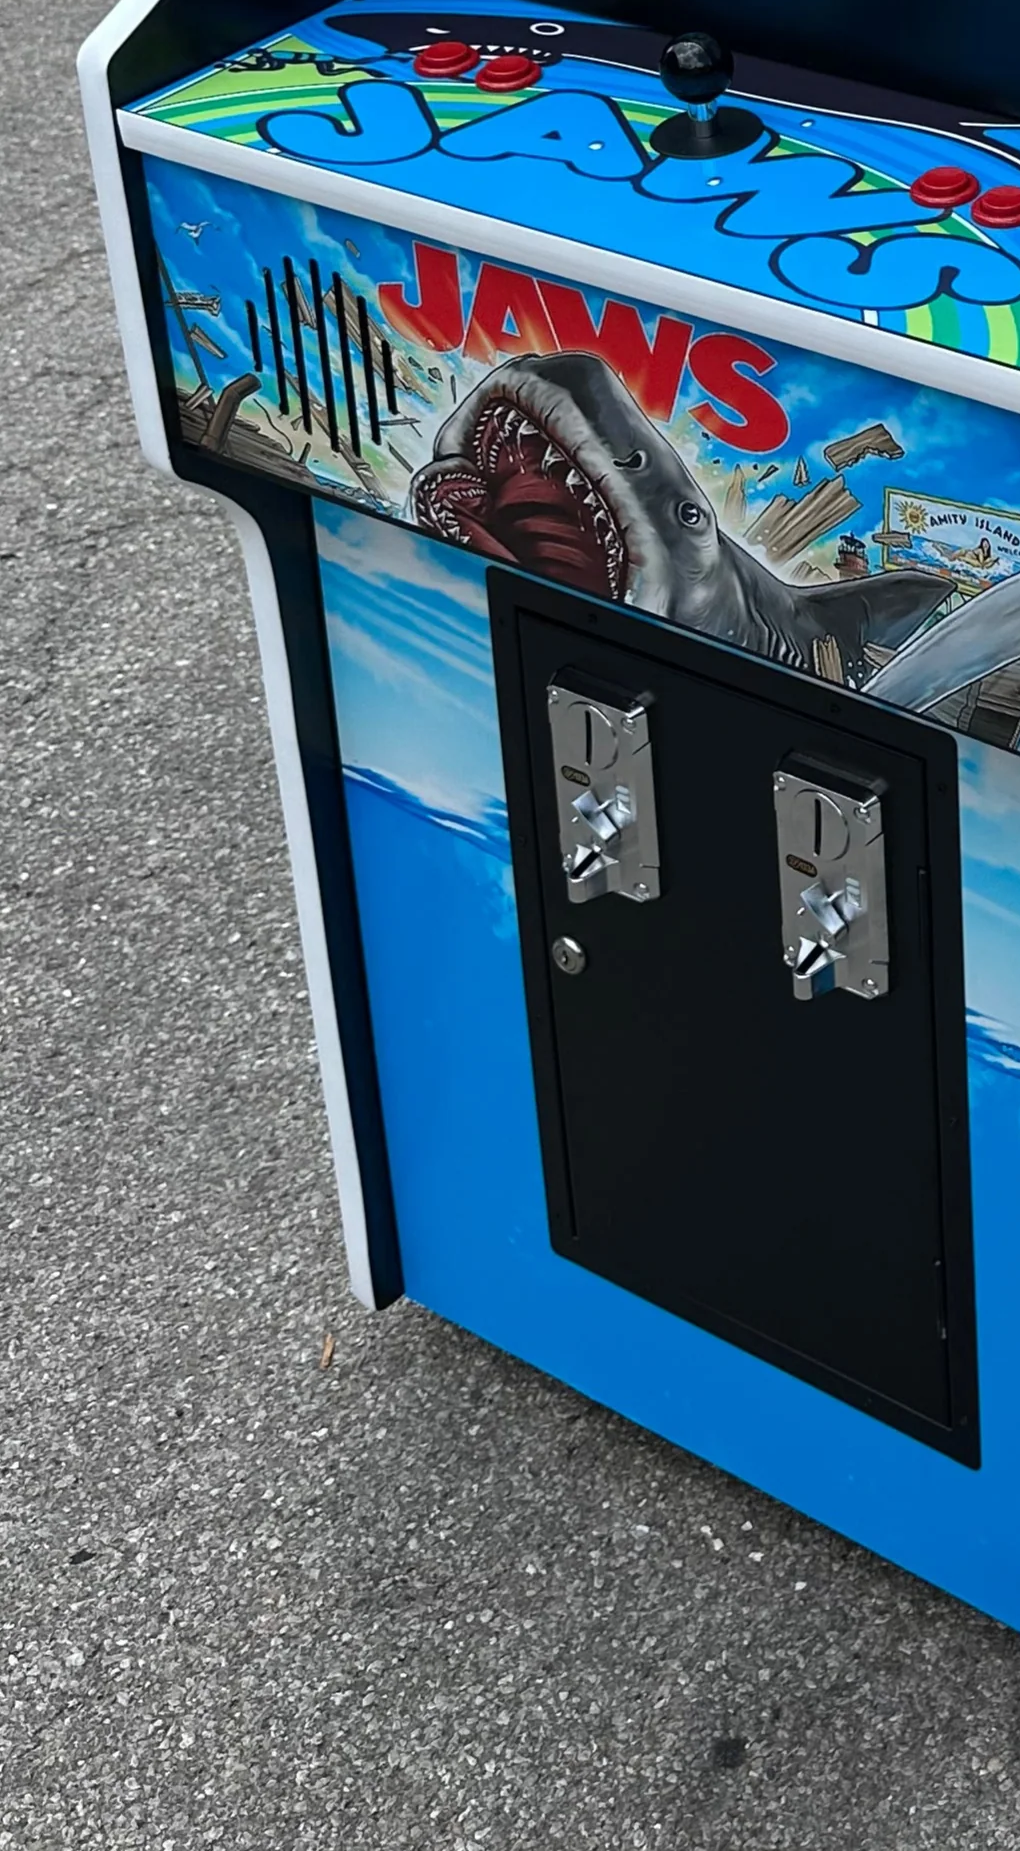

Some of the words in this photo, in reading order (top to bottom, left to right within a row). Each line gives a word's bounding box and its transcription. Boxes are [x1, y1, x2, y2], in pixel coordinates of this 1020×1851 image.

[378, 241, 789, 452] JAWS
[930, 513, 967, 527] AMITY
[975, 517, 1020, 546] ISLAND
